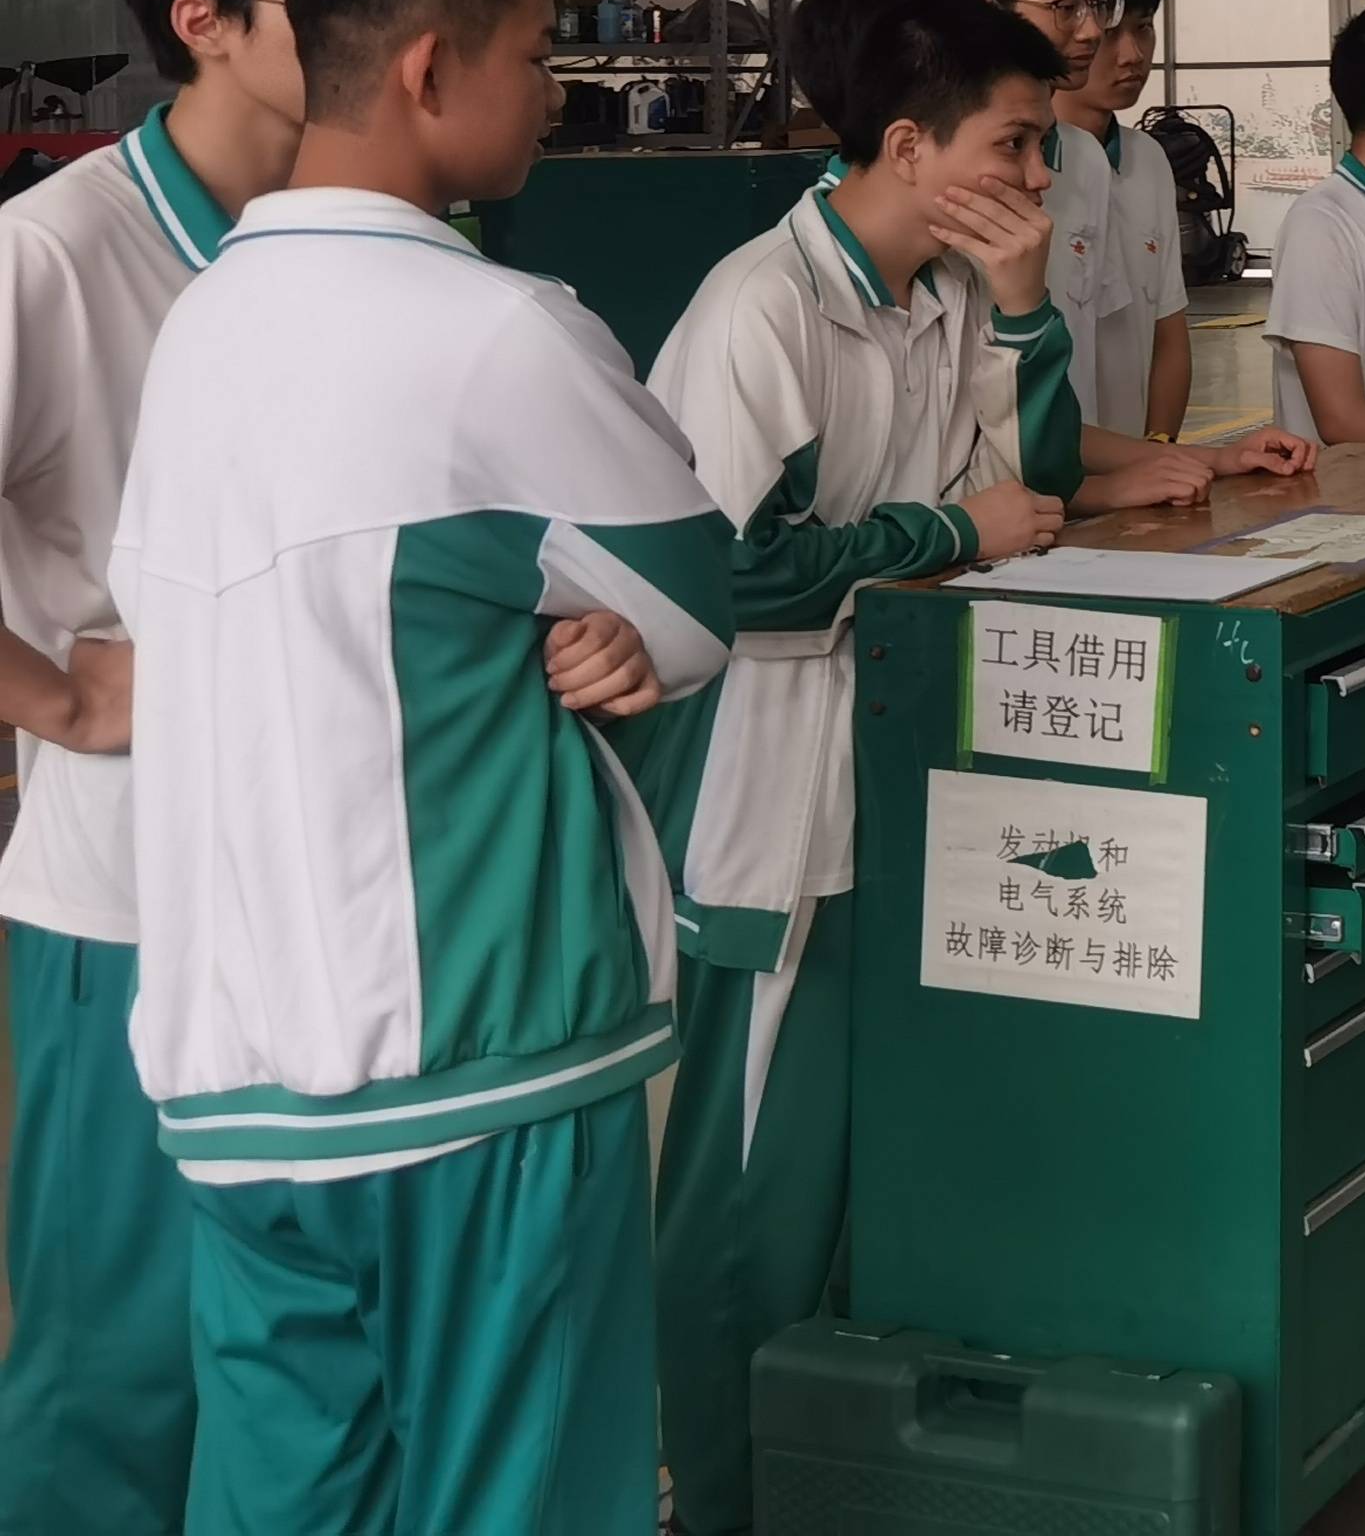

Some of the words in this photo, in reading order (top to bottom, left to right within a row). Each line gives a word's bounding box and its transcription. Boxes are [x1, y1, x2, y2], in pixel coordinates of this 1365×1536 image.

[981, 627, 1149, 683] 工具借用
[999, 690, 1124, 743] 请登记
[997, 881, 1128, 925] 电气系统
[944, 921, 1179, 981] 故障诊断与排除
